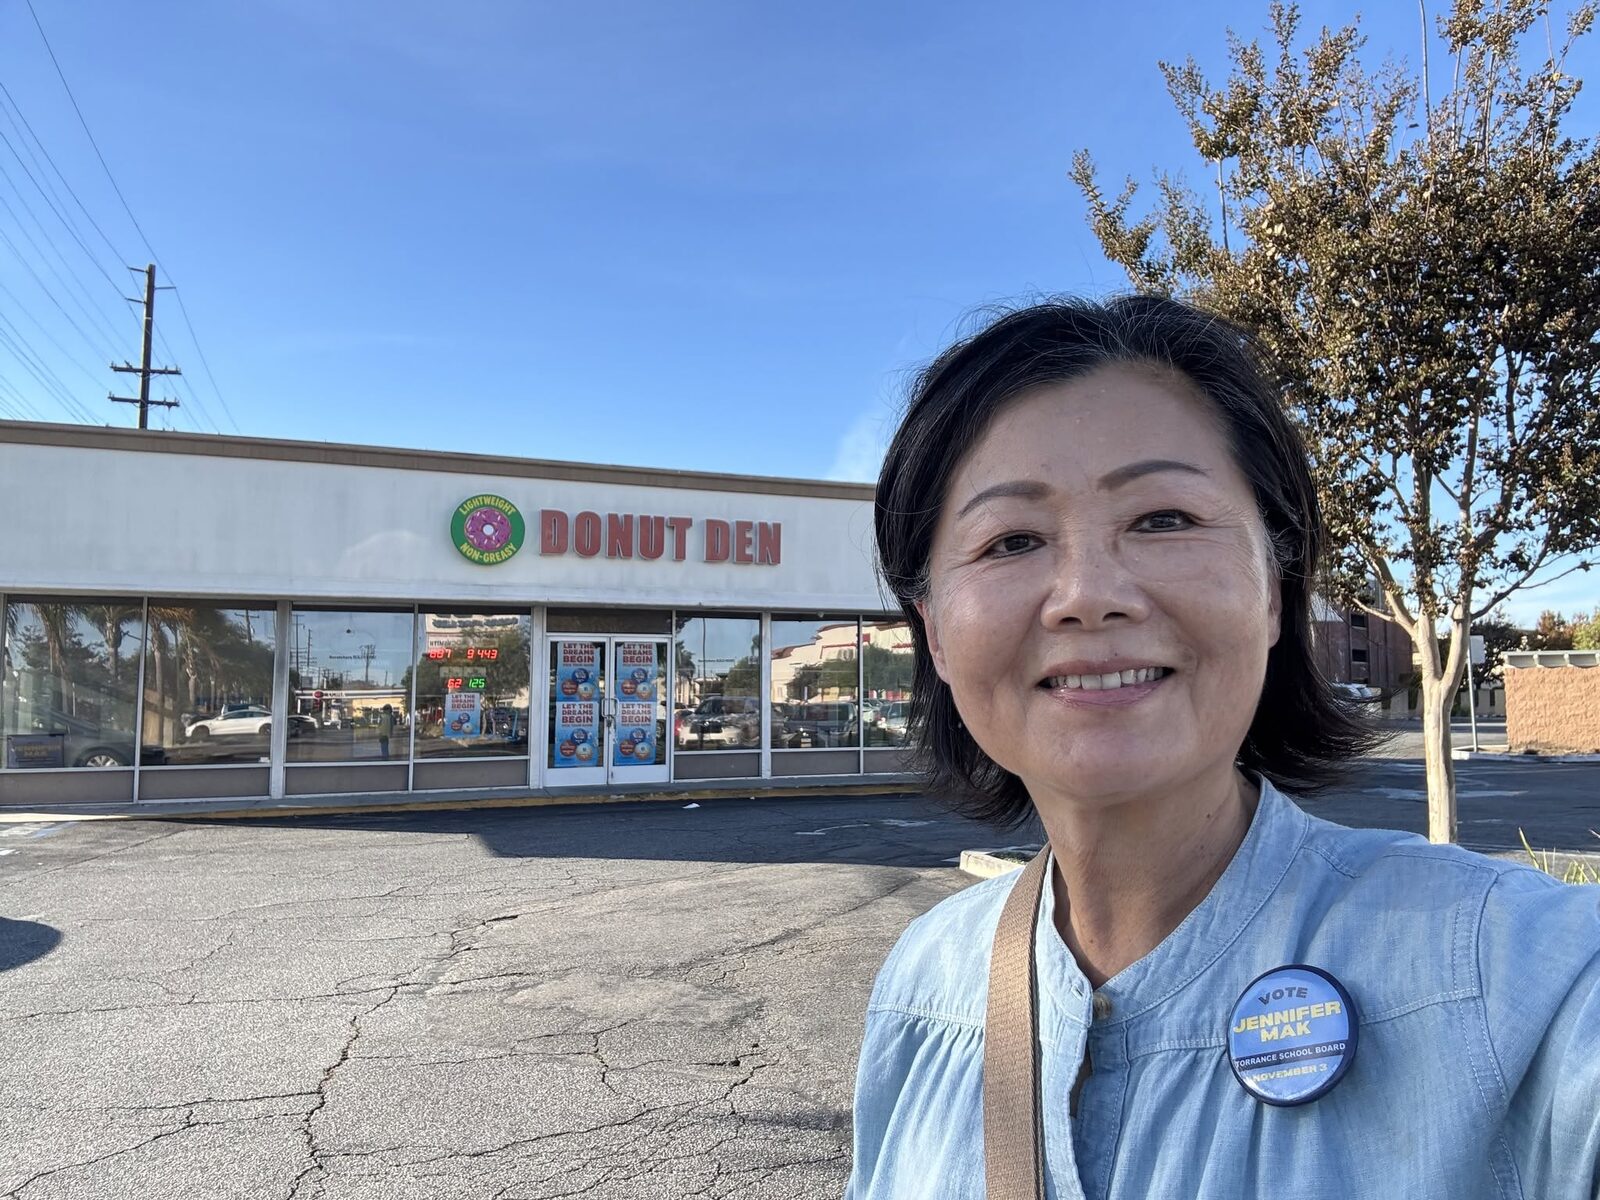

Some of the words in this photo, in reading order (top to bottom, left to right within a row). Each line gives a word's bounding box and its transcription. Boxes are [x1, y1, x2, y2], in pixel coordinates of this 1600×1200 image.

[459, 496, 516, 515] LIGHTWEIGHT
[540, 509, 693, 561] DONUT
[704, 518, 782, 565] DEN
[460, 542, 517, 562] NON-GREASY
[477, 648, 498, 659] 443
[563, 655, 594, 663] BEGIN
[447, 678, 462, 689] 62
[468, 678, 485, 688] 125
[562, 715, 593, 723] BEGIN
[621, 715, 652, 723] BEGIN
[1258, 986, 1308, 1005] VOTE
[1233, 1001, 1342, 1033] JENNIFER
[1260, 1020, 1312, 1042] MAK
[1234, 1053, 1277, 1068] TORRANCE
[1278, 1048, 1313, 1060] SCHOOL
[1315, 1043, 1346, 1054] BOARD
[1252, 1064, 1317, 1082] NOVEMBER
[1319, 1063, 1328, 1072] 3
